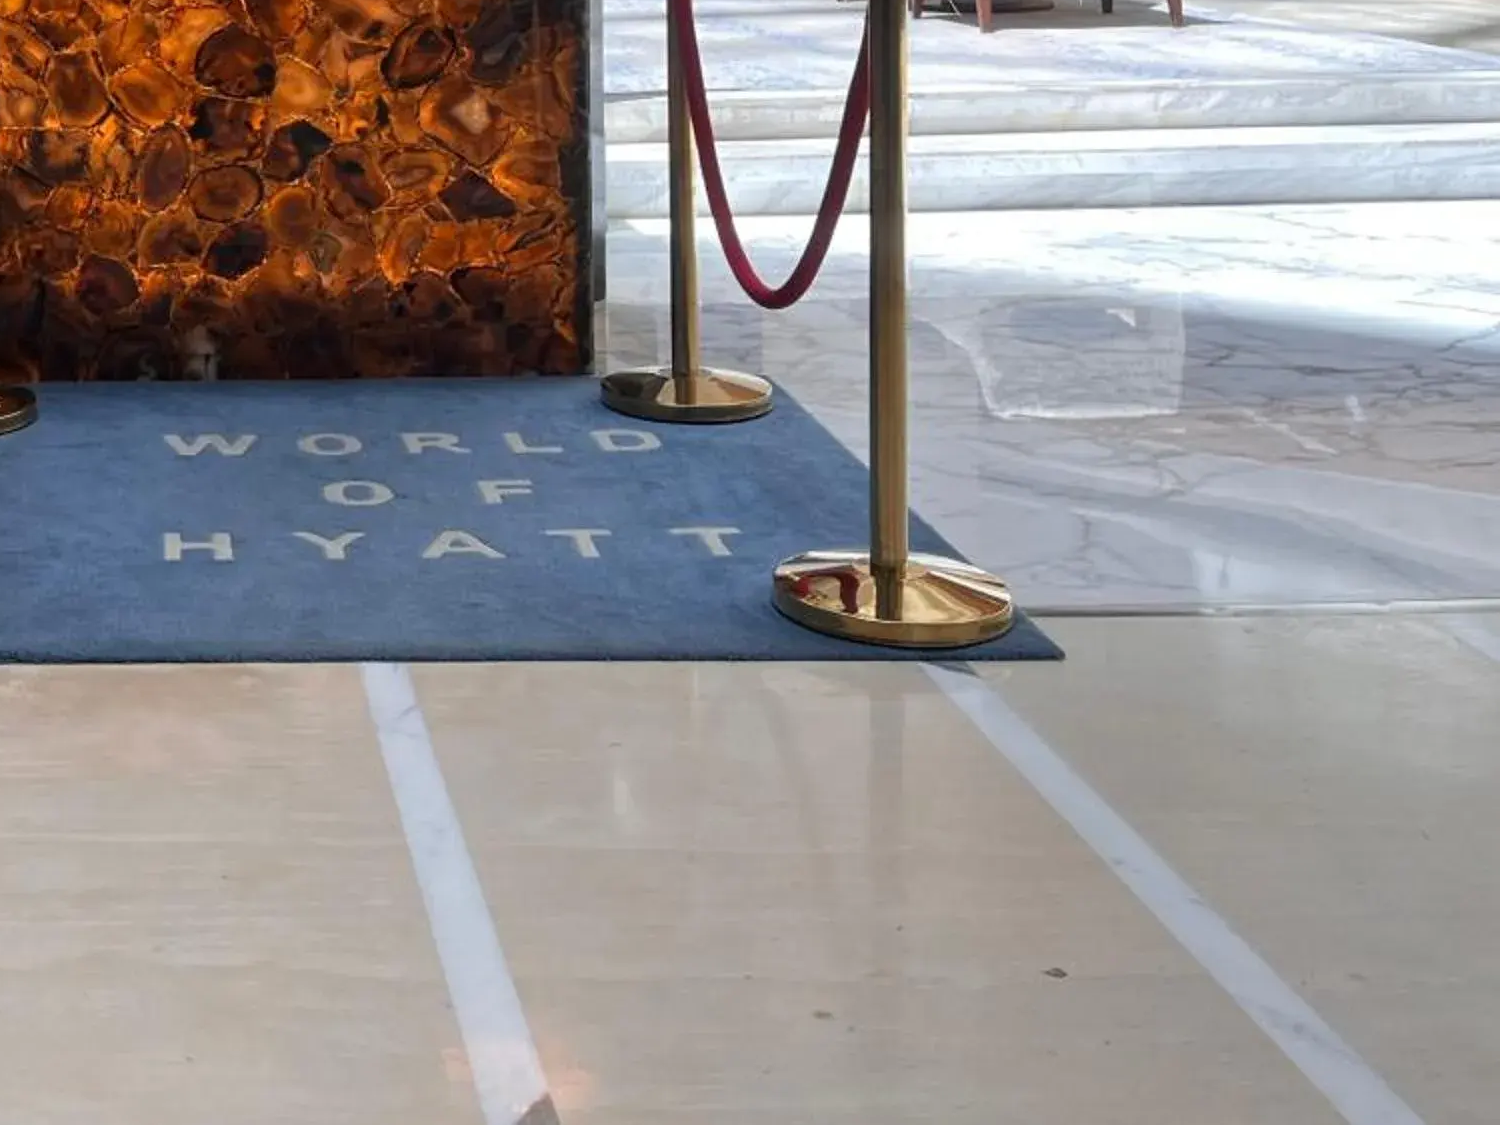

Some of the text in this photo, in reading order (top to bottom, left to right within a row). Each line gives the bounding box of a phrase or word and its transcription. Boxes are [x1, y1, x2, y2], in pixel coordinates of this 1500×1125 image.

[163, 429, 663, 457] WORLD
[322, 480, 533, 507] OF
[163, 527, 742, 561] HYATT
